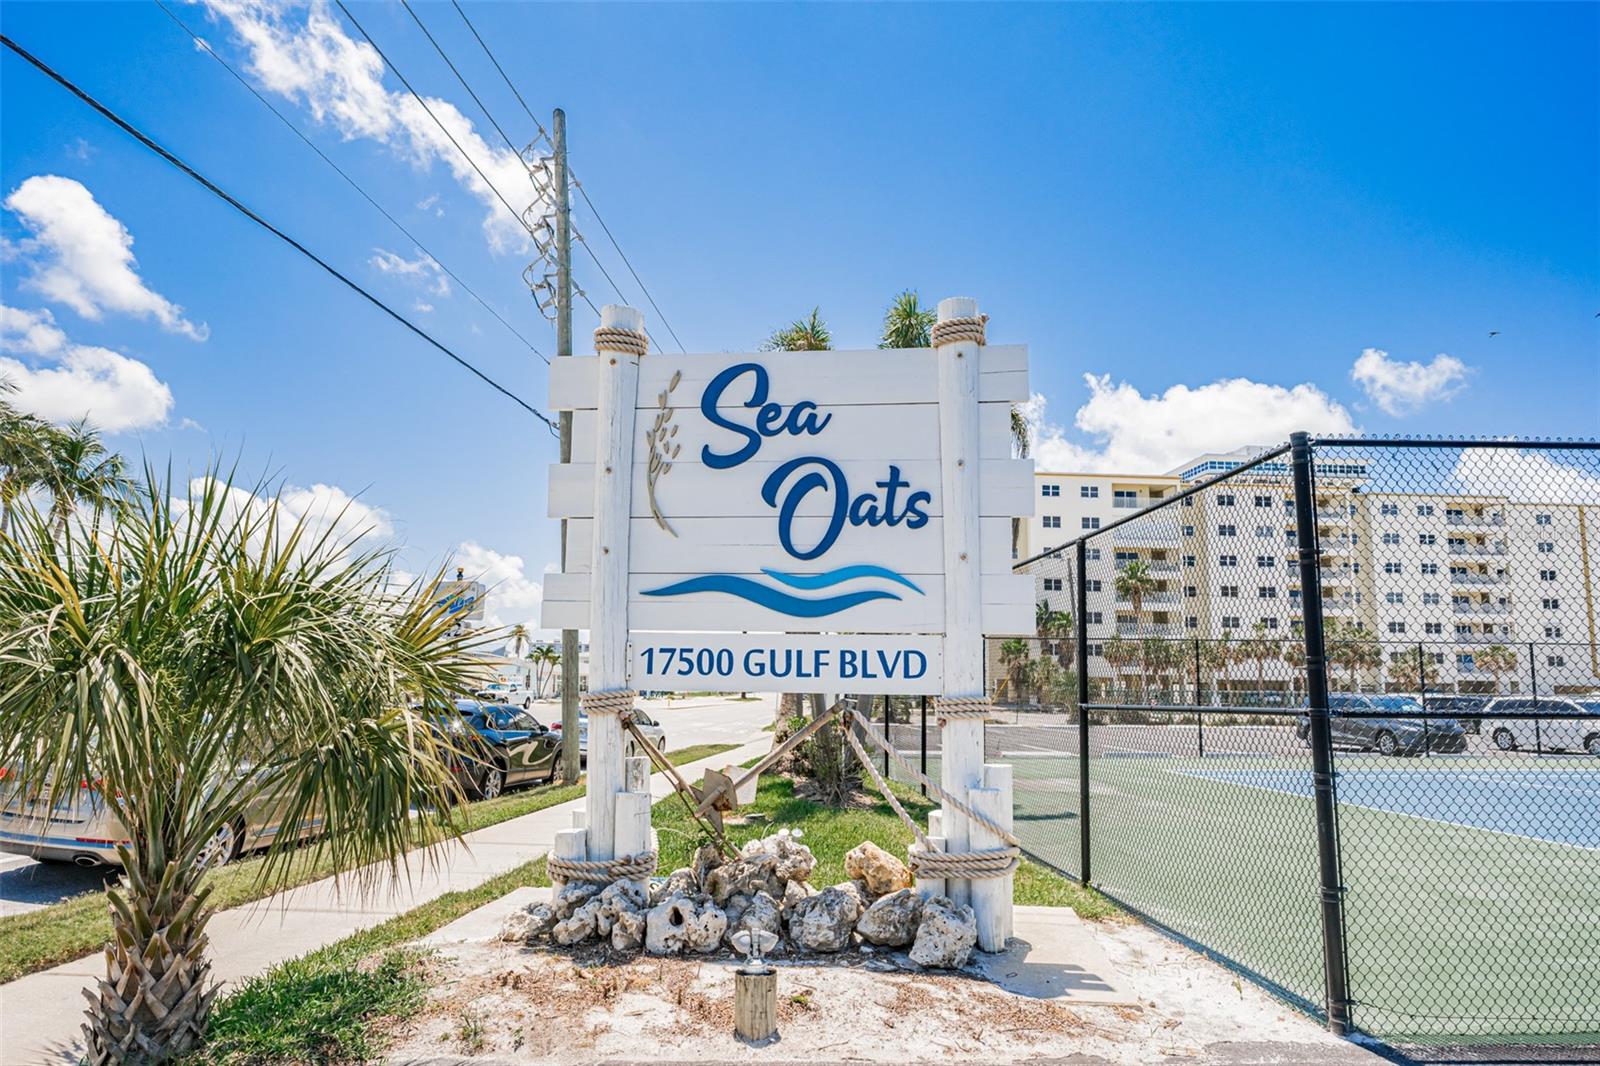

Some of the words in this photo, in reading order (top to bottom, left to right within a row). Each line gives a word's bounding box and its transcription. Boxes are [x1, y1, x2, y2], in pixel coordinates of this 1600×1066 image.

[700, 362, 832, 470] Sea
[761, 456, 932, 561] Oats
[640, 647, 734, 676] 17500
[743, 649, 830, 678] GULF
[839, 649, 928, 679] BLVD
